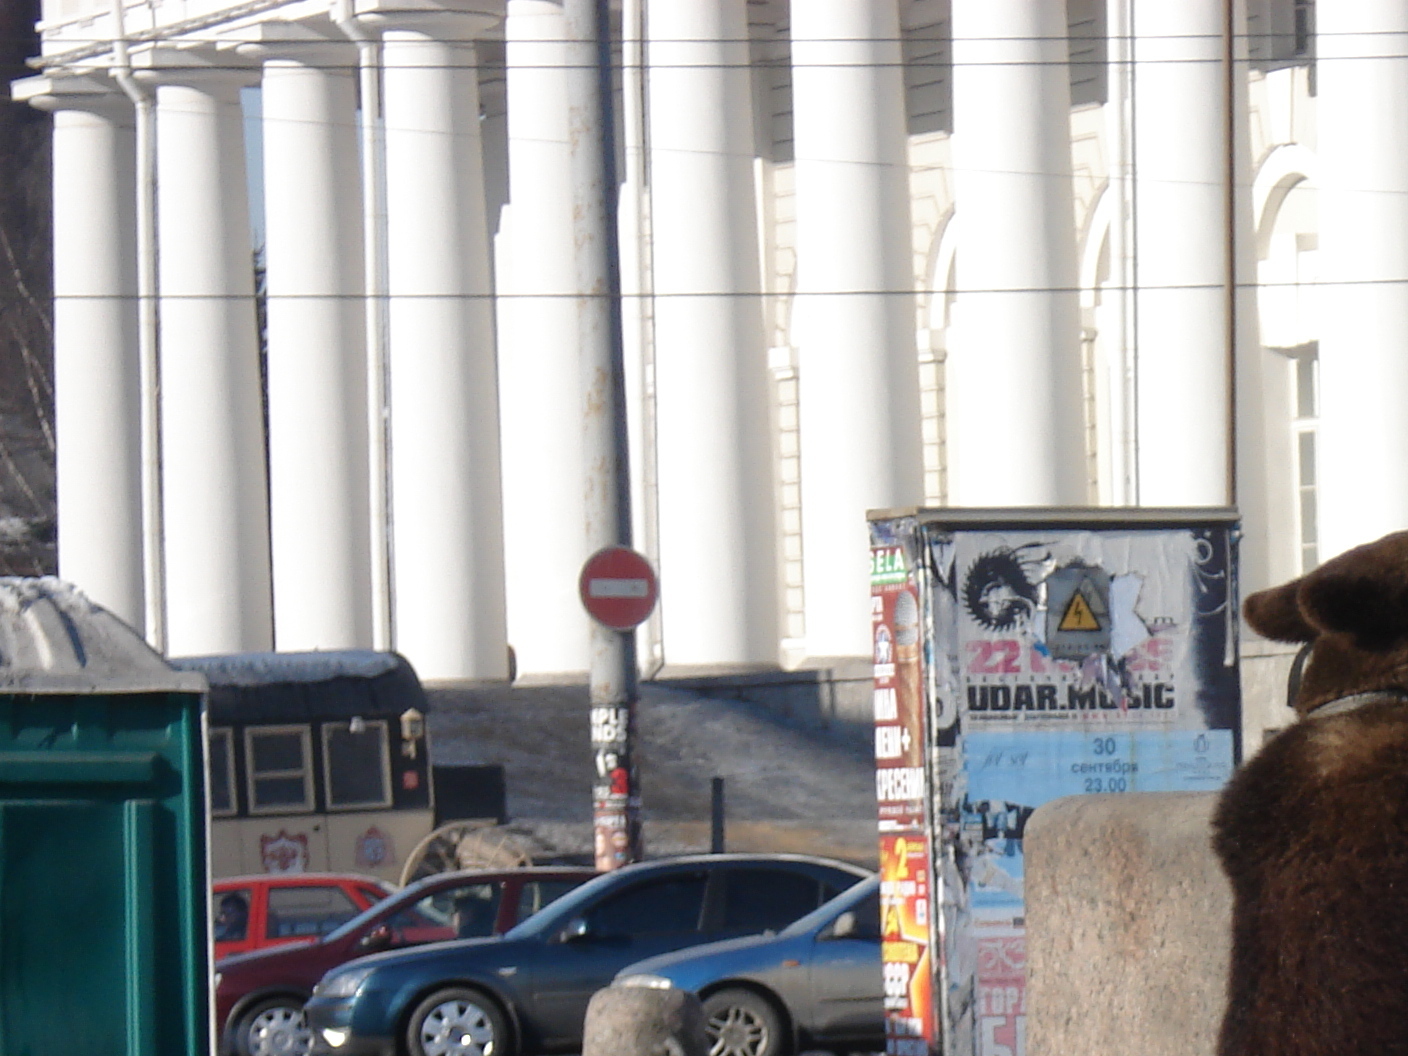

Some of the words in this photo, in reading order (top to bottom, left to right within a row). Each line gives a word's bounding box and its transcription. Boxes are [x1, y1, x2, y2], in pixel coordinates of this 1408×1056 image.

[1093, 737, 1116, 756] 30
[1071, 761, 1139, 774] сентября
[1084, 777, 1127, 793] 23.00
